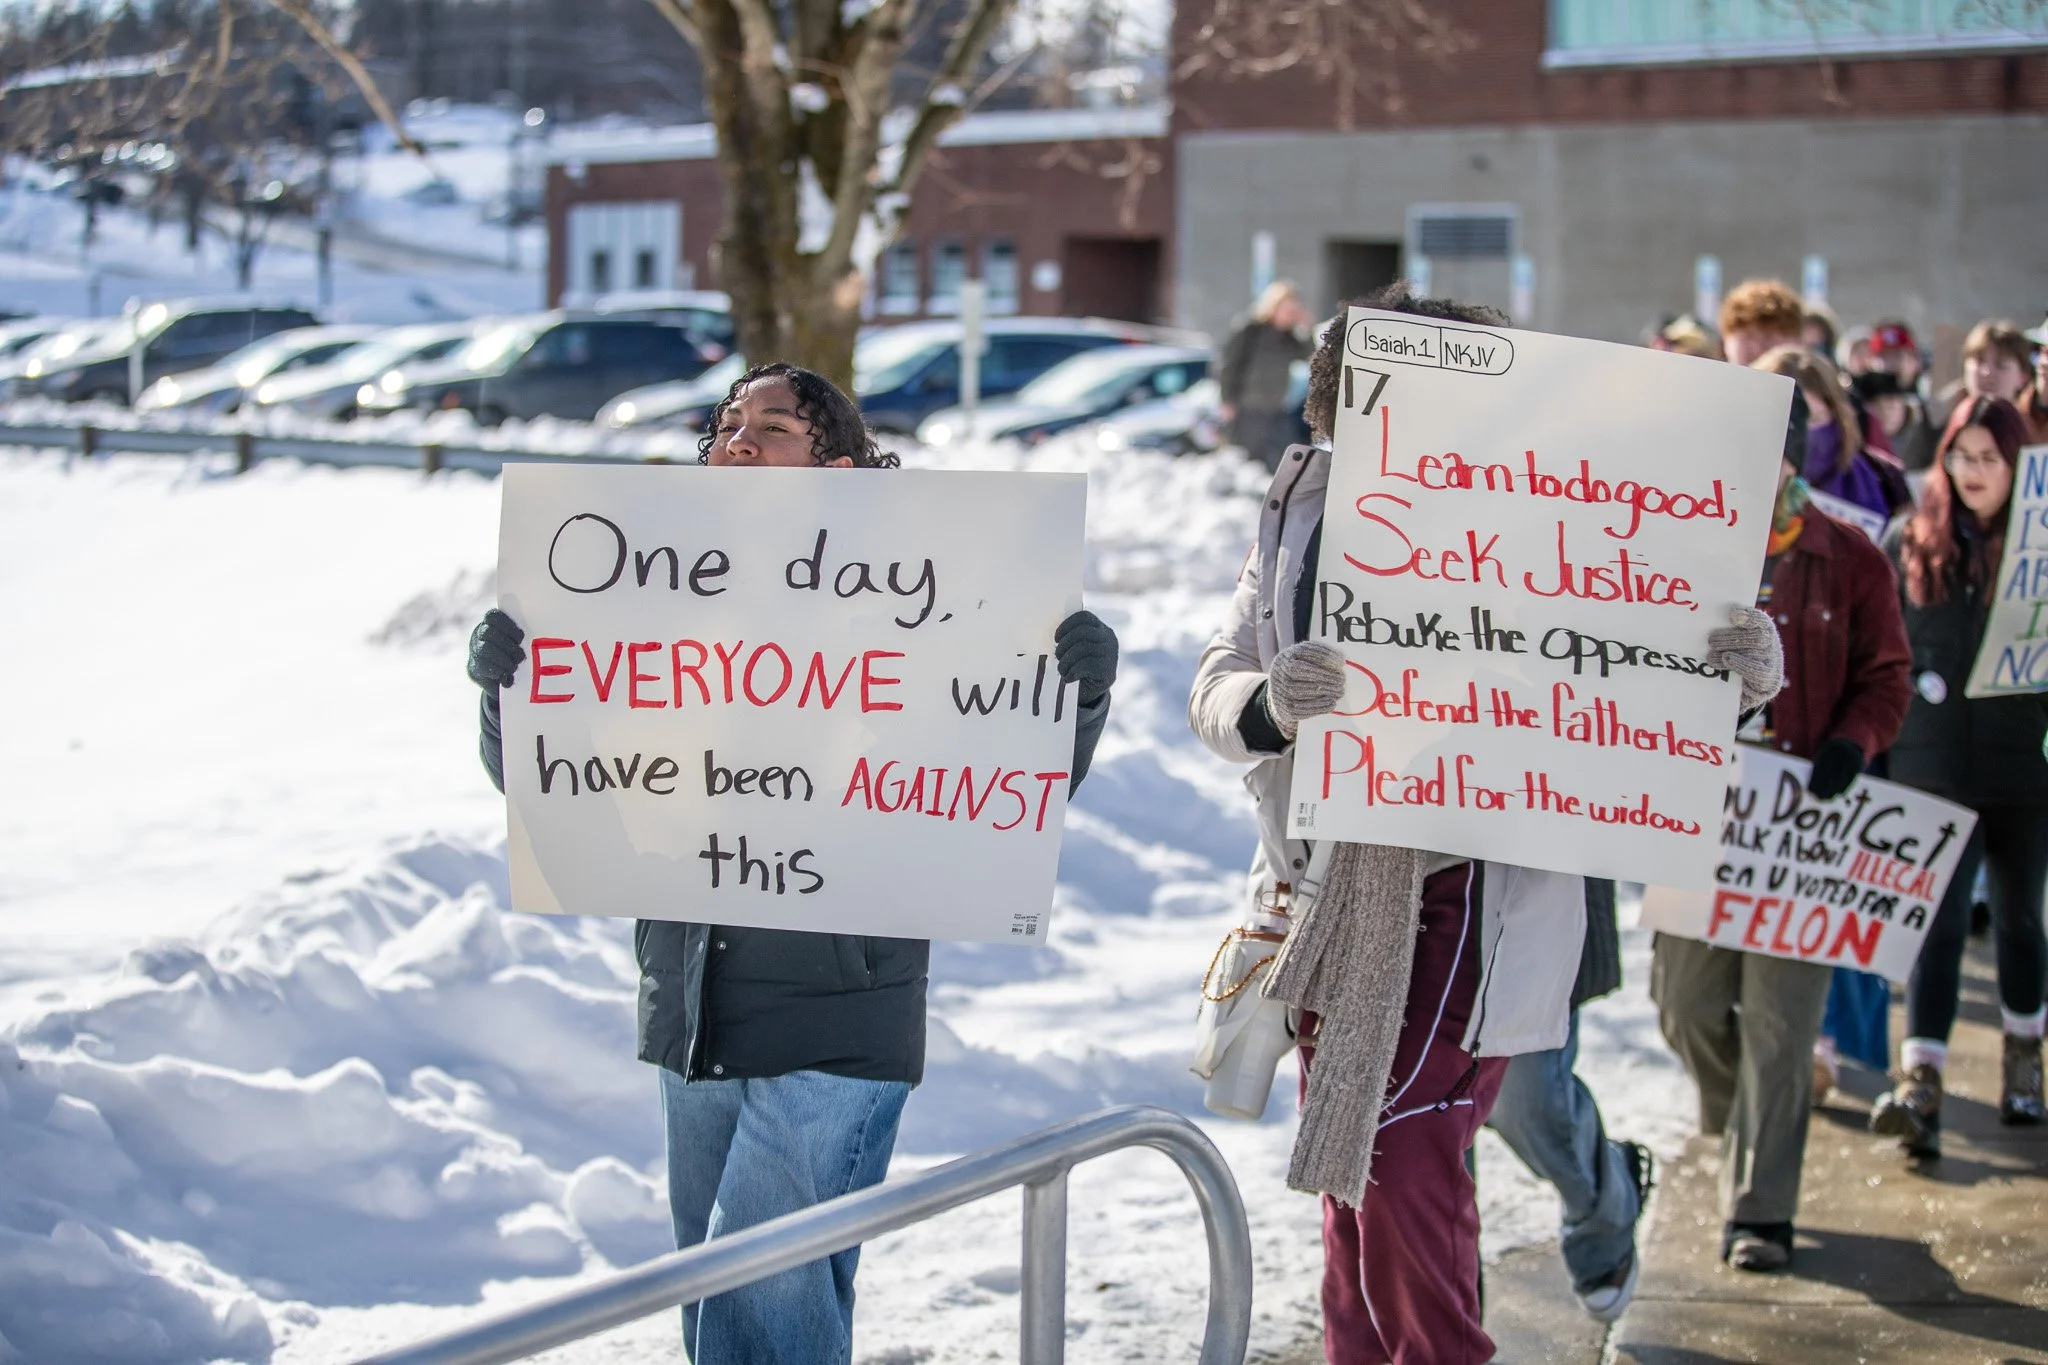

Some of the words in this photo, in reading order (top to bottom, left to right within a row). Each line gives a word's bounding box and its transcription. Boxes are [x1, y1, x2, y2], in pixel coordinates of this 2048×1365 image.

[1344, 365, 1391, 416] 17
[1444, 341, 1496, 368] NKJV
[1381, 406, 1514, 492] Learn
[1515, 450, 1563, 497] to
[1564, 459, 1611, 503] do
[2023, 453, 2048, 499] N
[548, 513, 730, 596] One
[785, 529, 953, 629] day,
[1524, 521, 1699, 611] Justice,
[1319, 581, 1461, 651] Rebuke
[1463, 606, 1528, 653] the
[530, 638, 906, 712] EVERYONE
[952, 653, 1067, 723] will
[1331, 660, 1479, 723] Defend
[1484, 688, 1542, 728] the
[1552, 682, 1723, 766] fatherless
[536, 735, 679, 796] have
[704, 750, 813, 801] been
[841, 757, 1069, 832] AGAINST
[1322, 730, 1445, 806] Plead
[1456, 754, 1516, 811] for
[1515, 771, 1584, 816] the
[1589, 794, 1701, 836] widow
[700, 833, 824, 895] this
[1720, 820, 1771, 854] ALK
[1846, 849, 1936, 903] ILLEGAL
[1706, 890, 1884, 968] FELON
